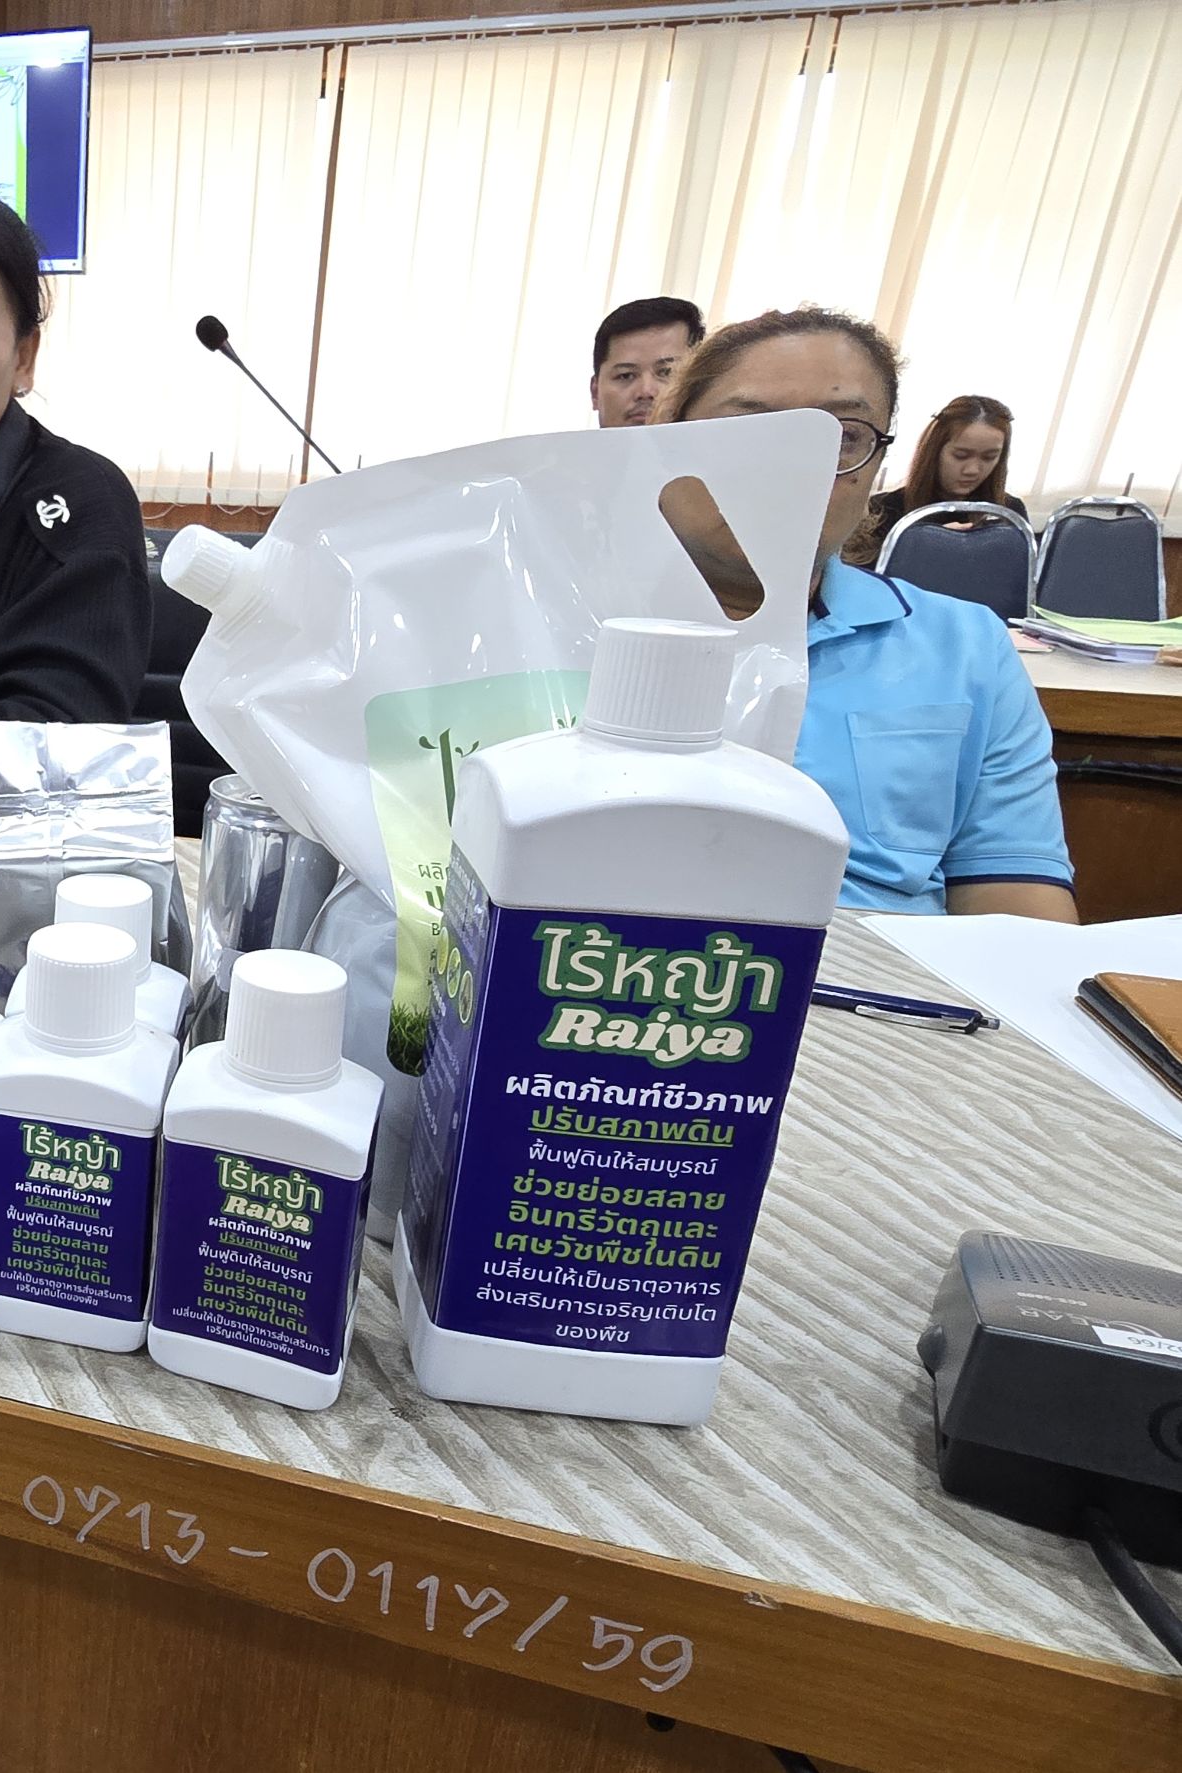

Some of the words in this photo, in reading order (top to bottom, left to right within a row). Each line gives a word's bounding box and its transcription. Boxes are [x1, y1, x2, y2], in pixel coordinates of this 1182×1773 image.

[541, 926, 777, 1016] ไร้หญ้า
[548, 1006, 747, 1064] Raiya
[505, 1073, 774, 1115] ผลิตภัณฑ์ชีวภาพ
[22, 1124, 119, 1168] ไร้หญ้า
[528, 1104, 735, 1148] ปรับสภาพดิน
[29, 1162, 110, 1190] Raiya
[528, 1138, 720, 1178] ฟื้นฟูดินให้สมบูรณ์
[218, 1157, 321, 1210] ไร้หญ้า
[512, 1169, 727, 1212] ช่วยย่อยสลาย
[6, 1208, 114, 1238] ฟื้นฟูดินให้สมบูรณ์
[223, 1195, 311, 1233] Raiya
[508, 1199, 719, 1243] อินทรีวัตถุและ
[12, 1225, 109, 1254] ช่วยย่อยสลาย
[493, 1232, 723, 1269] เศษวัชพืชในดิน
[198, 1242, 314, 1284] ฟื้นฟูดินให้สมบูรณ์
[203, 1262, 307, 1302] ช่วยย่อยสลาย
[482, 1257, 722, 1299] เปลี่ยนให้เป็นธาตุอาหาร
[475, 1282, 717, 1324] ส่งเสริมการเจริญเติบโต
[555, 1322, 631, 1344] ของพืช
